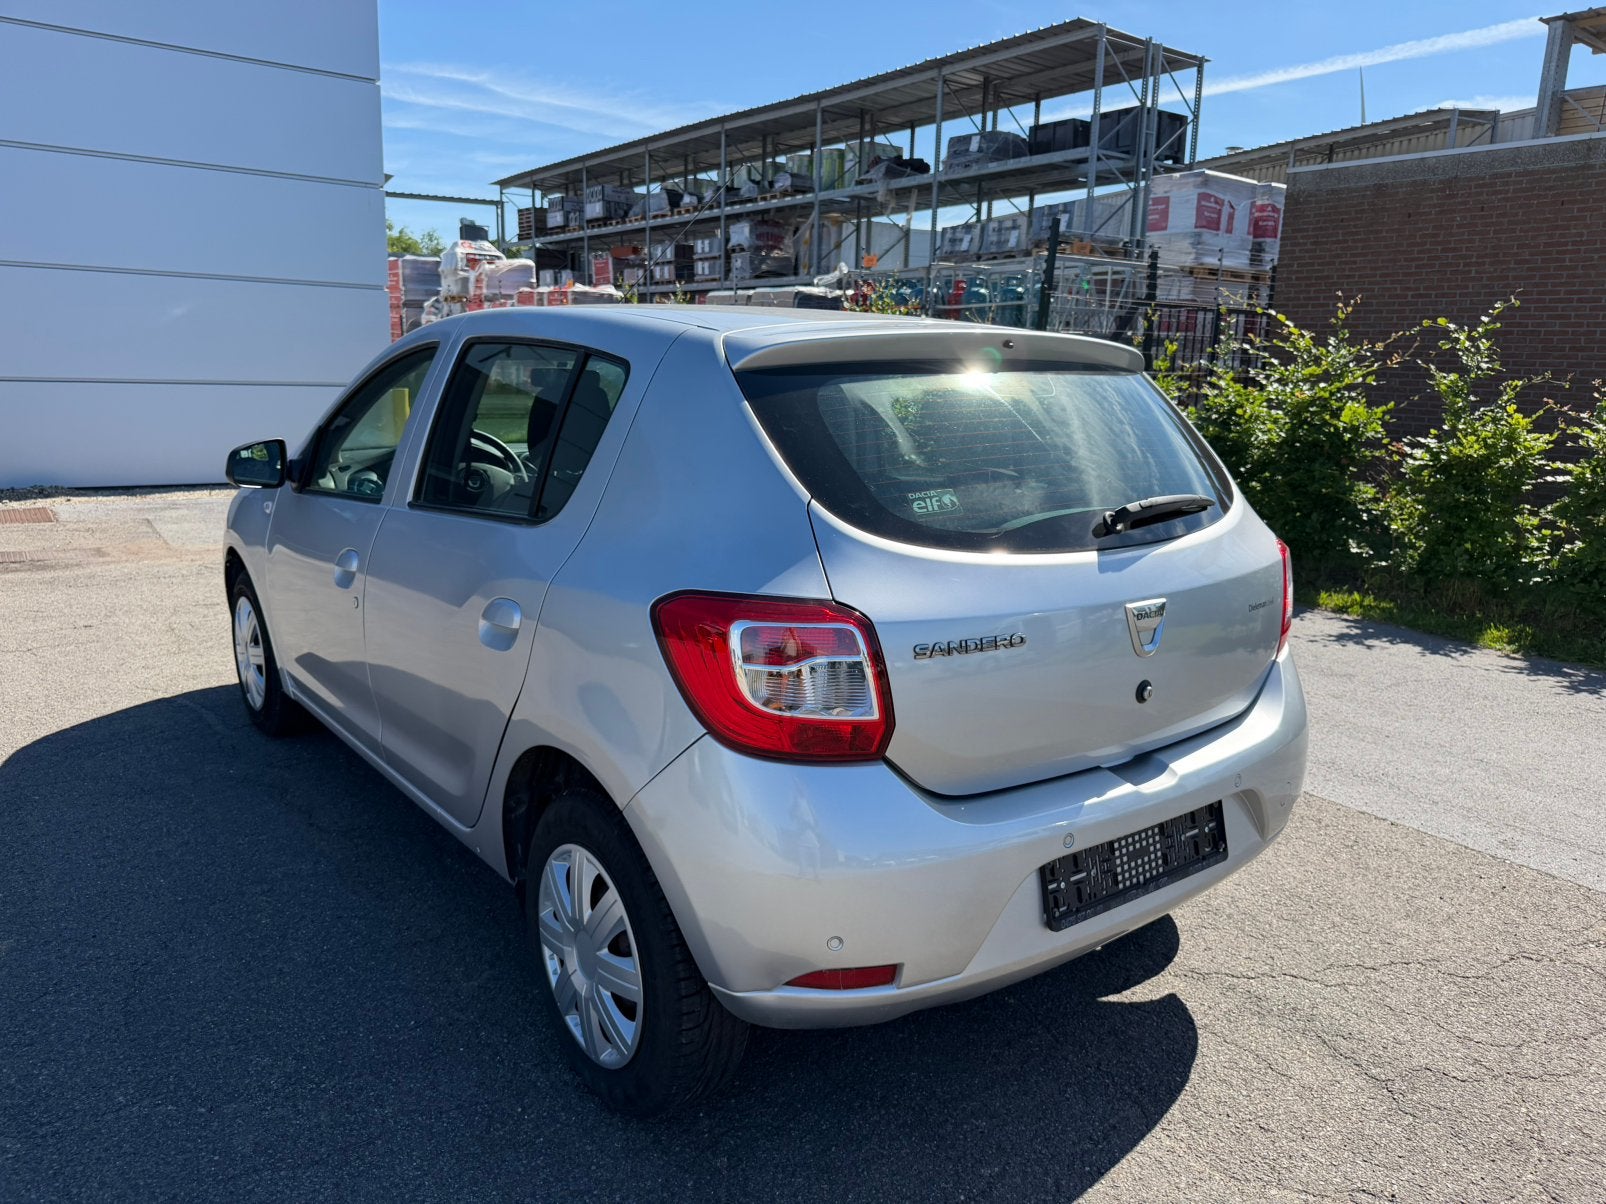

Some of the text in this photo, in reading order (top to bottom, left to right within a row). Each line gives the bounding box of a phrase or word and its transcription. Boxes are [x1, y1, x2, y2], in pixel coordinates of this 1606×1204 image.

[908, 490, 938, 499] DACIA
[912, 497, 941, 512] elf
[1136, 610, 1164, 621] DACIA
[913, 631, 1027, 660] SANDERO
